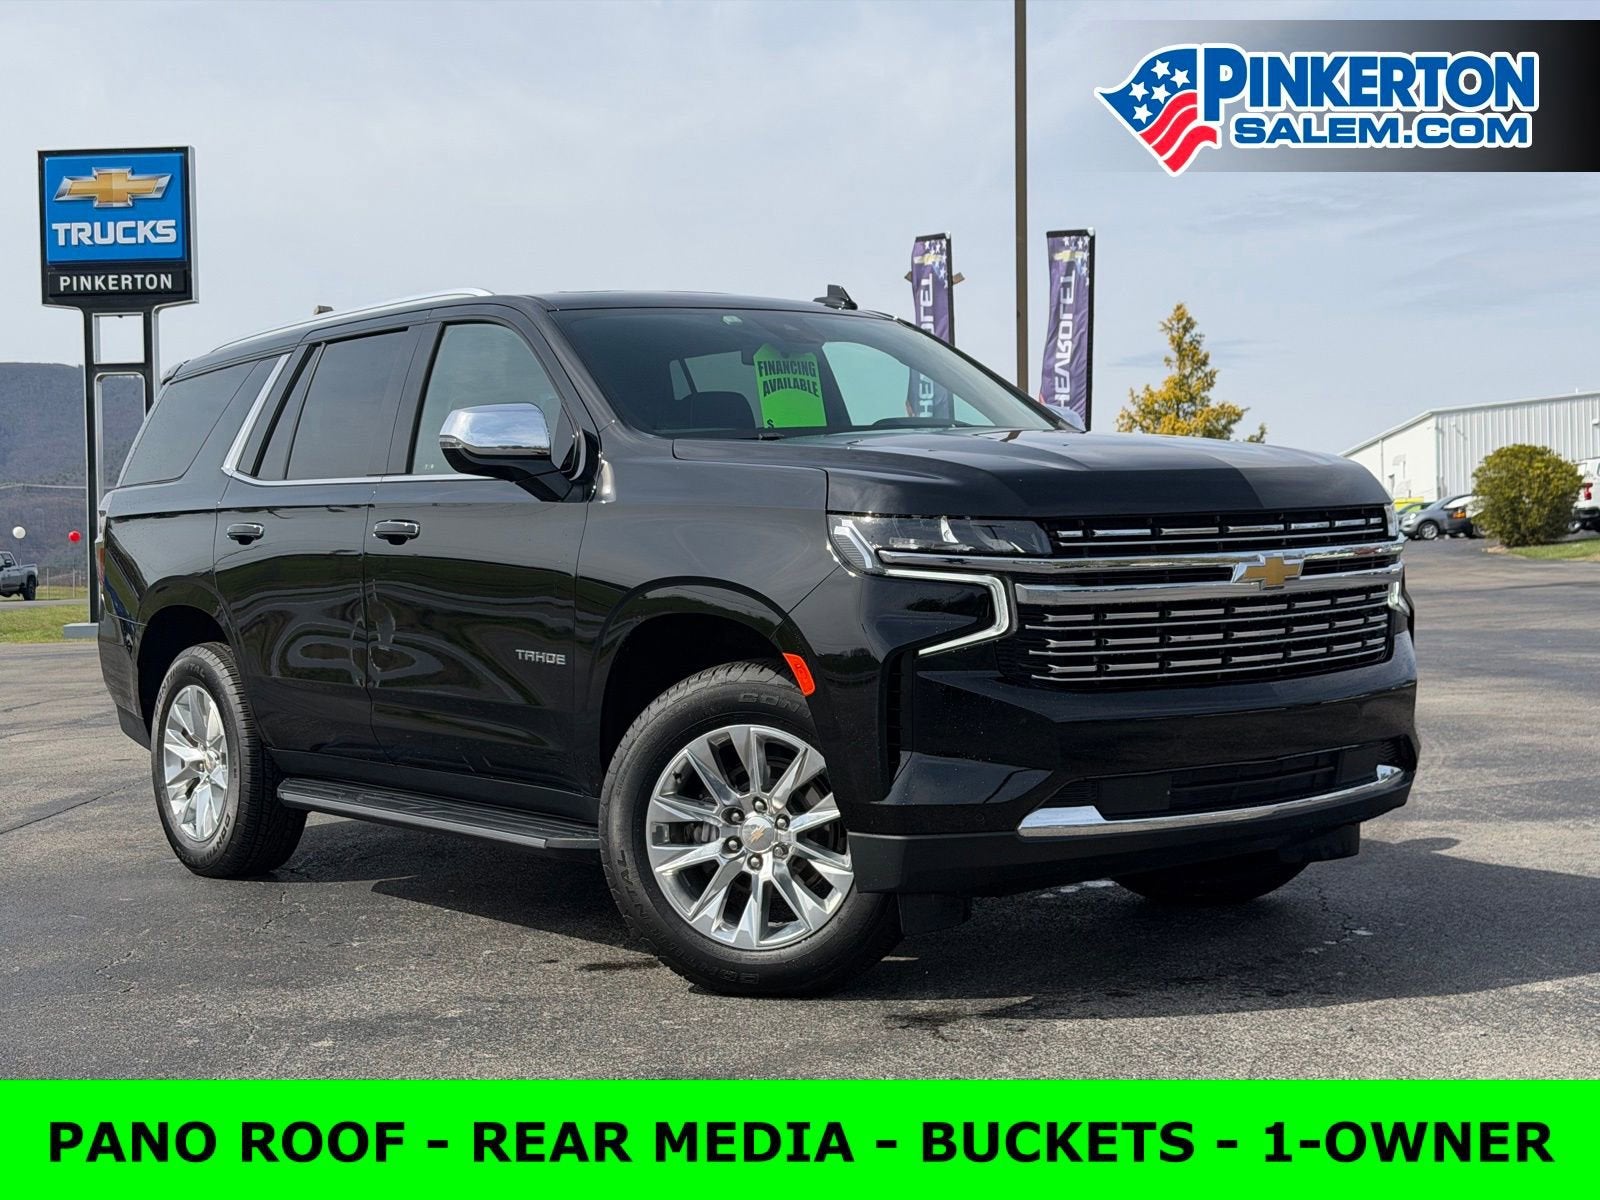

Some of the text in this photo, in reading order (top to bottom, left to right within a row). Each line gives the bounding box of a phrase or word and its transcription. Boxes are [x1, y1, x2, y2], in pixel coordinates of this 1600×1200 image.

[51, 219, 176, 246] TRUCKS
[59, 273, 173, 291] PINKERTON
[1054, 269, 1076, 409] HEVROLET
[757, 360, 817, 378] FINANCING
[763, 378, 820, 397] AVAILABLE
[515, 649, 566, 665] TAHOE
